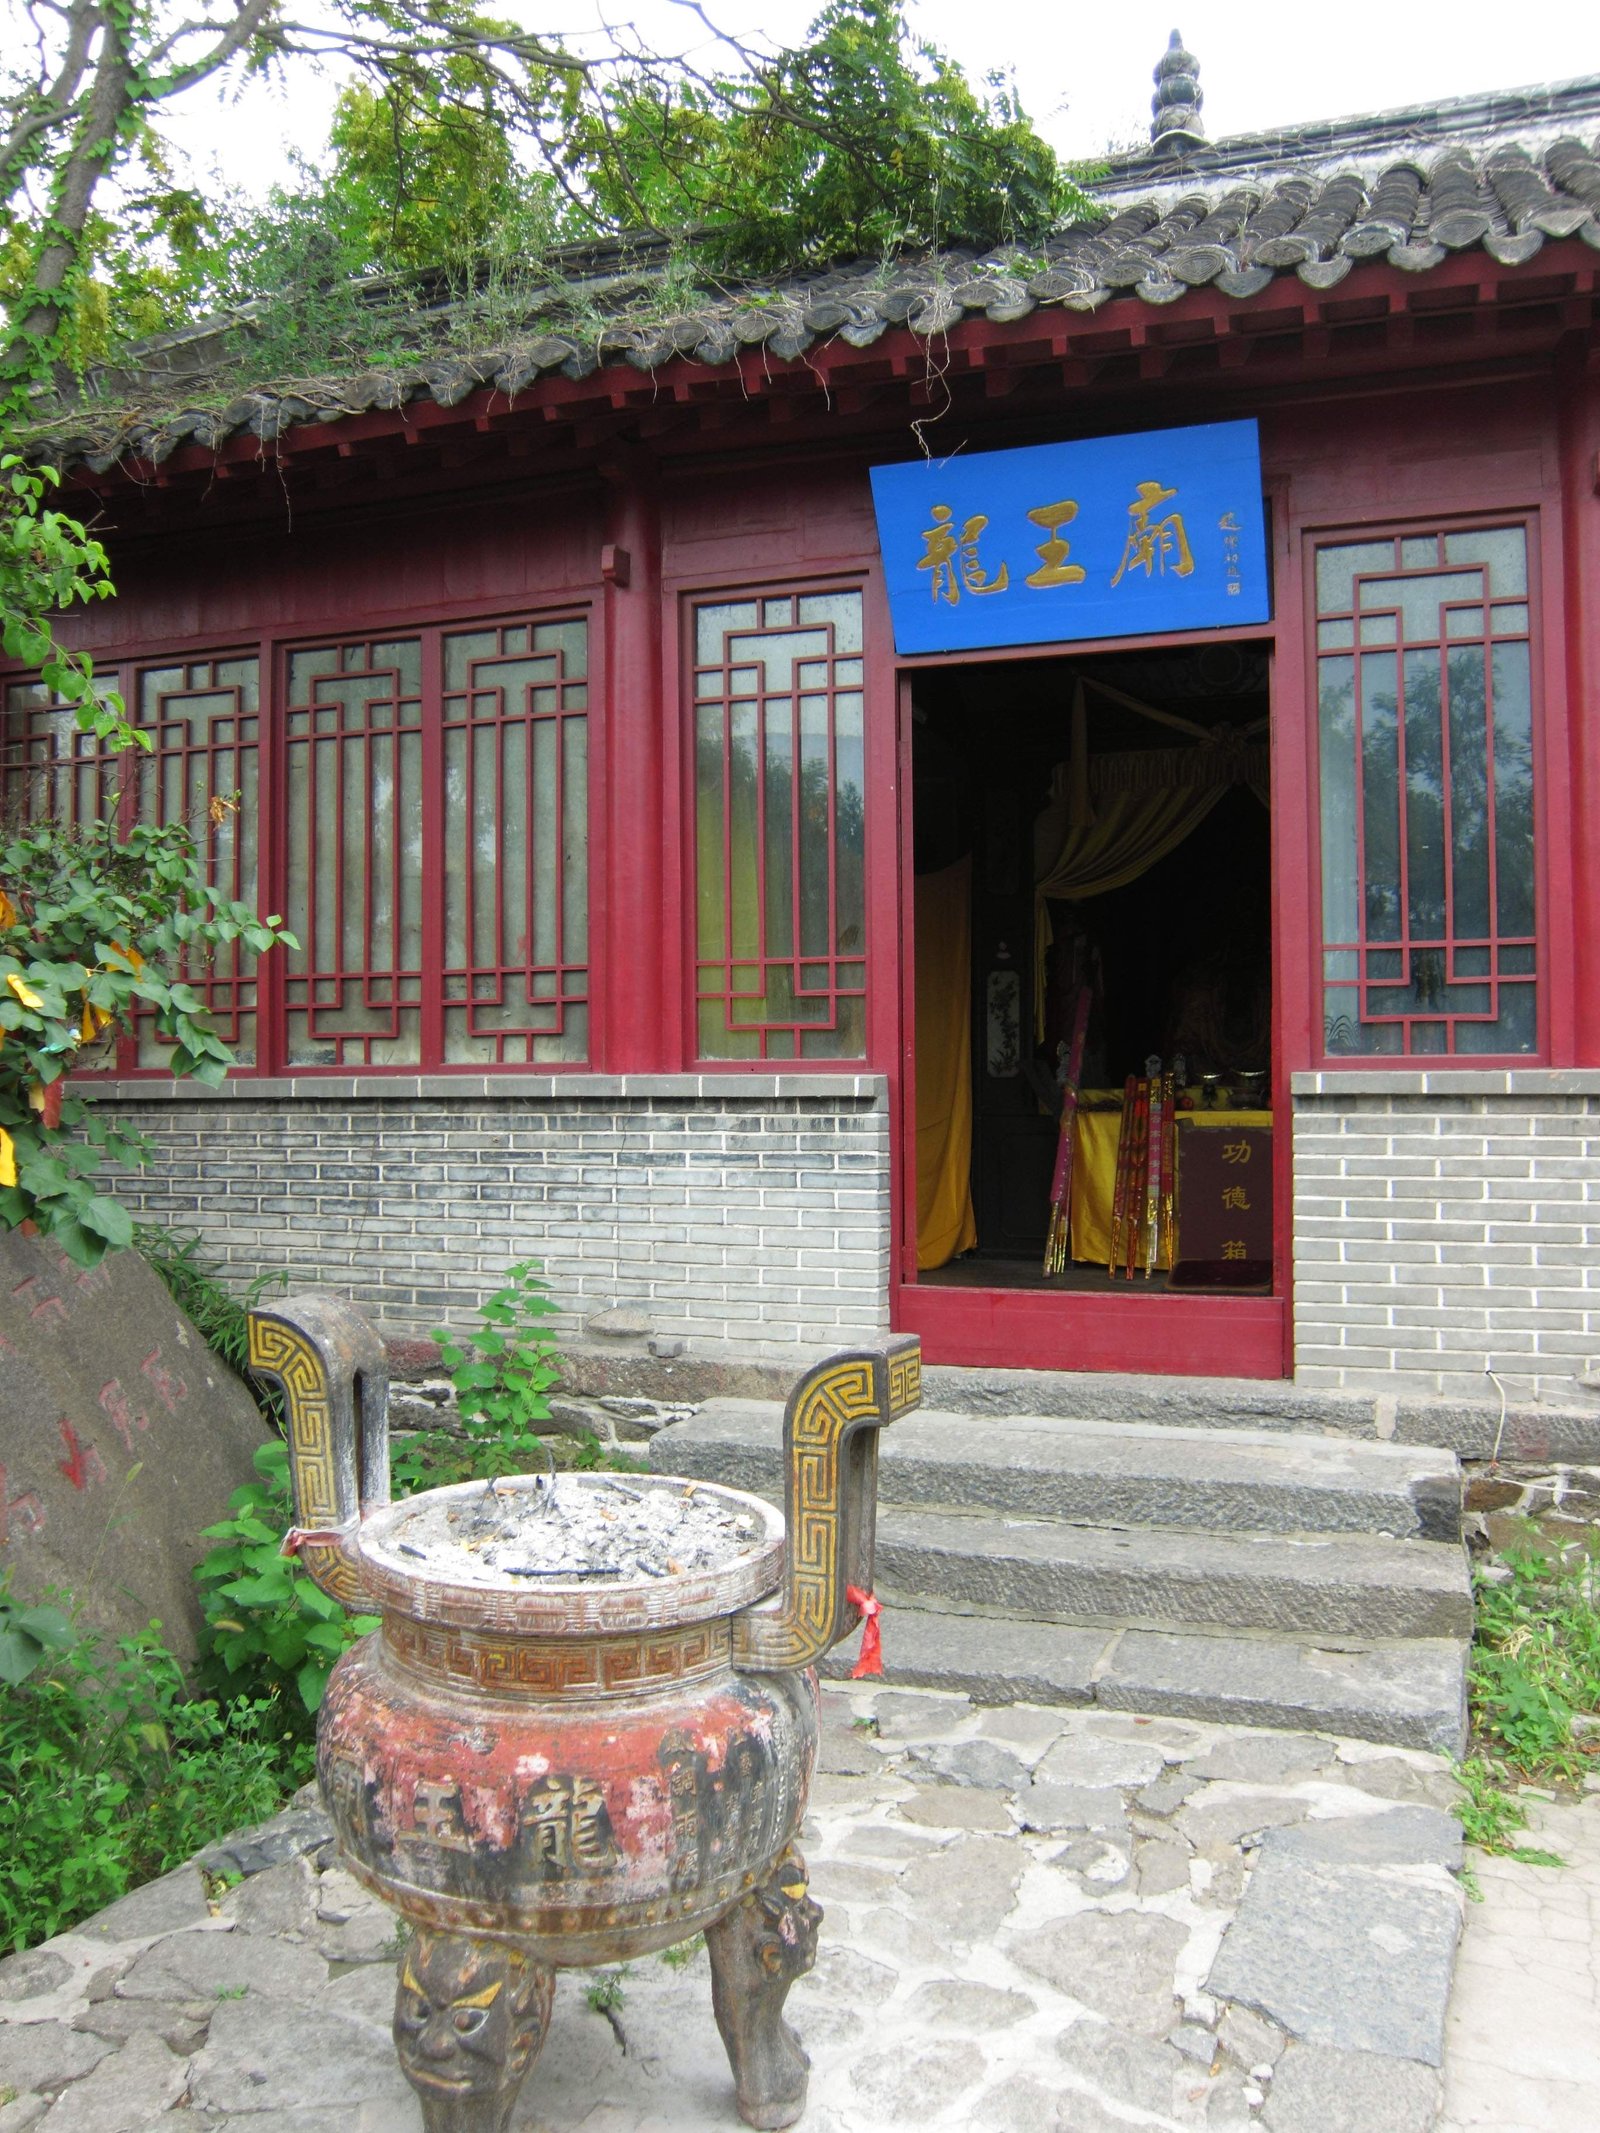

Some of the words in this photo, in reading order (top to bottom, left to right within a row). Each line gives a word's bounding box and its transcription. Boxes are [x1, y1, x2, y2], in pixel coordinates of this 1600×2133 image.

[916, 480, 1195, 606] 龍王廟
[1221, 1139, 1253, 1261] 功德箱
